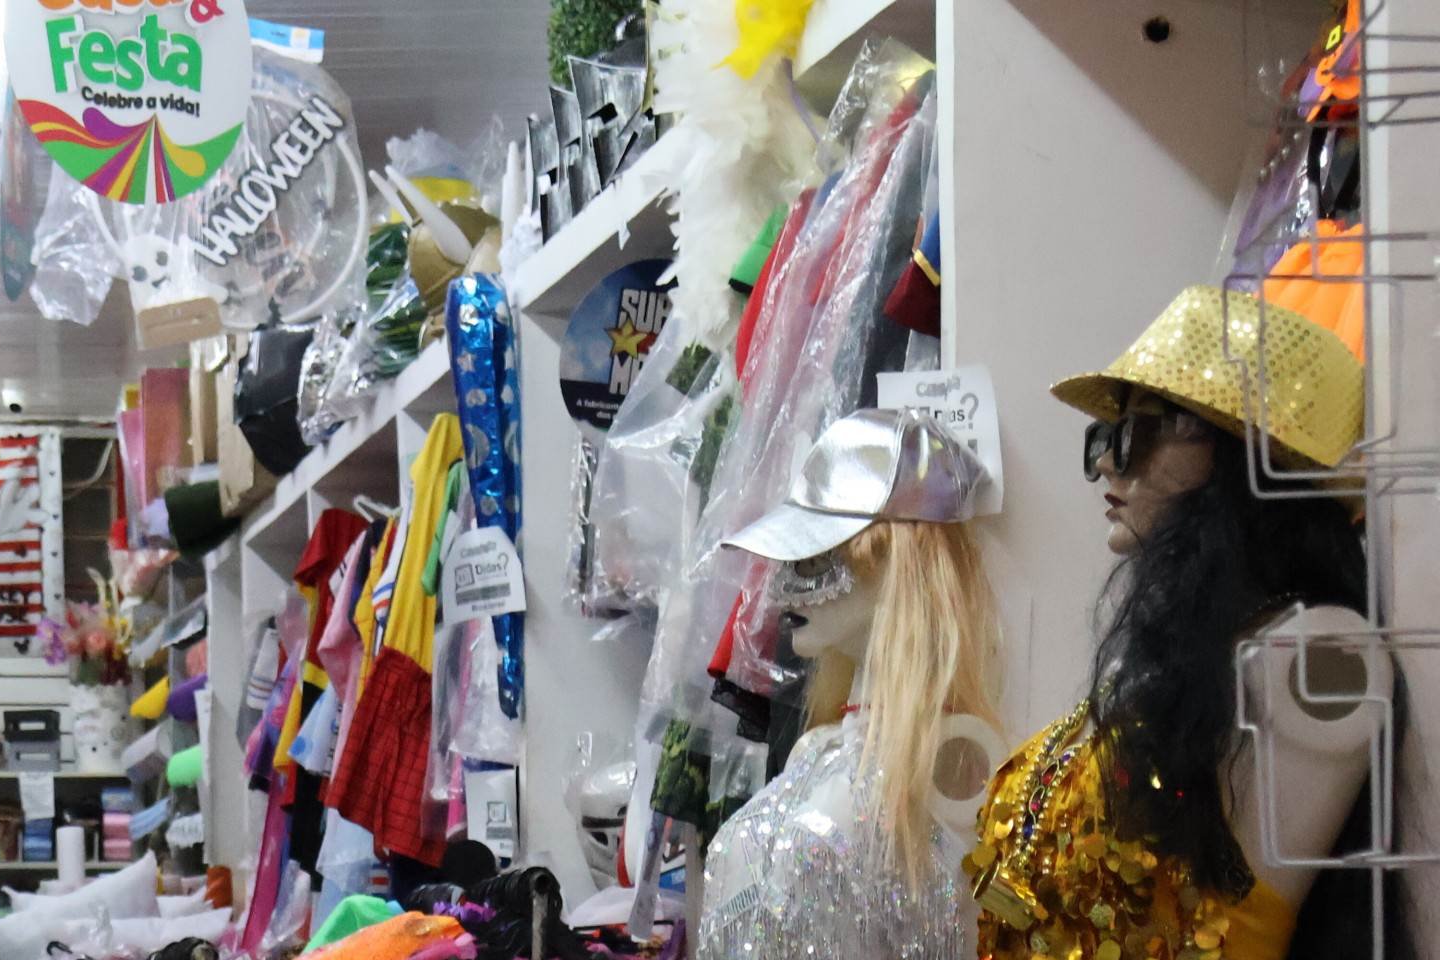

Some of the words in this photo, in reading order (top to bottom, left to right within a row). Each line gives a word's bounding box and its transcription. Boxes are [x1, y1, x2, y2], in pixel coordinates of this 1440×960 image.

[45, 13, 203, 94] Festa
[81, 85, 145, 111] Celebre
[147, 95, 157, 109] a
[160, 93, 201, 118] vida!
[190, 95, 344, 266] HALLOWEEN
